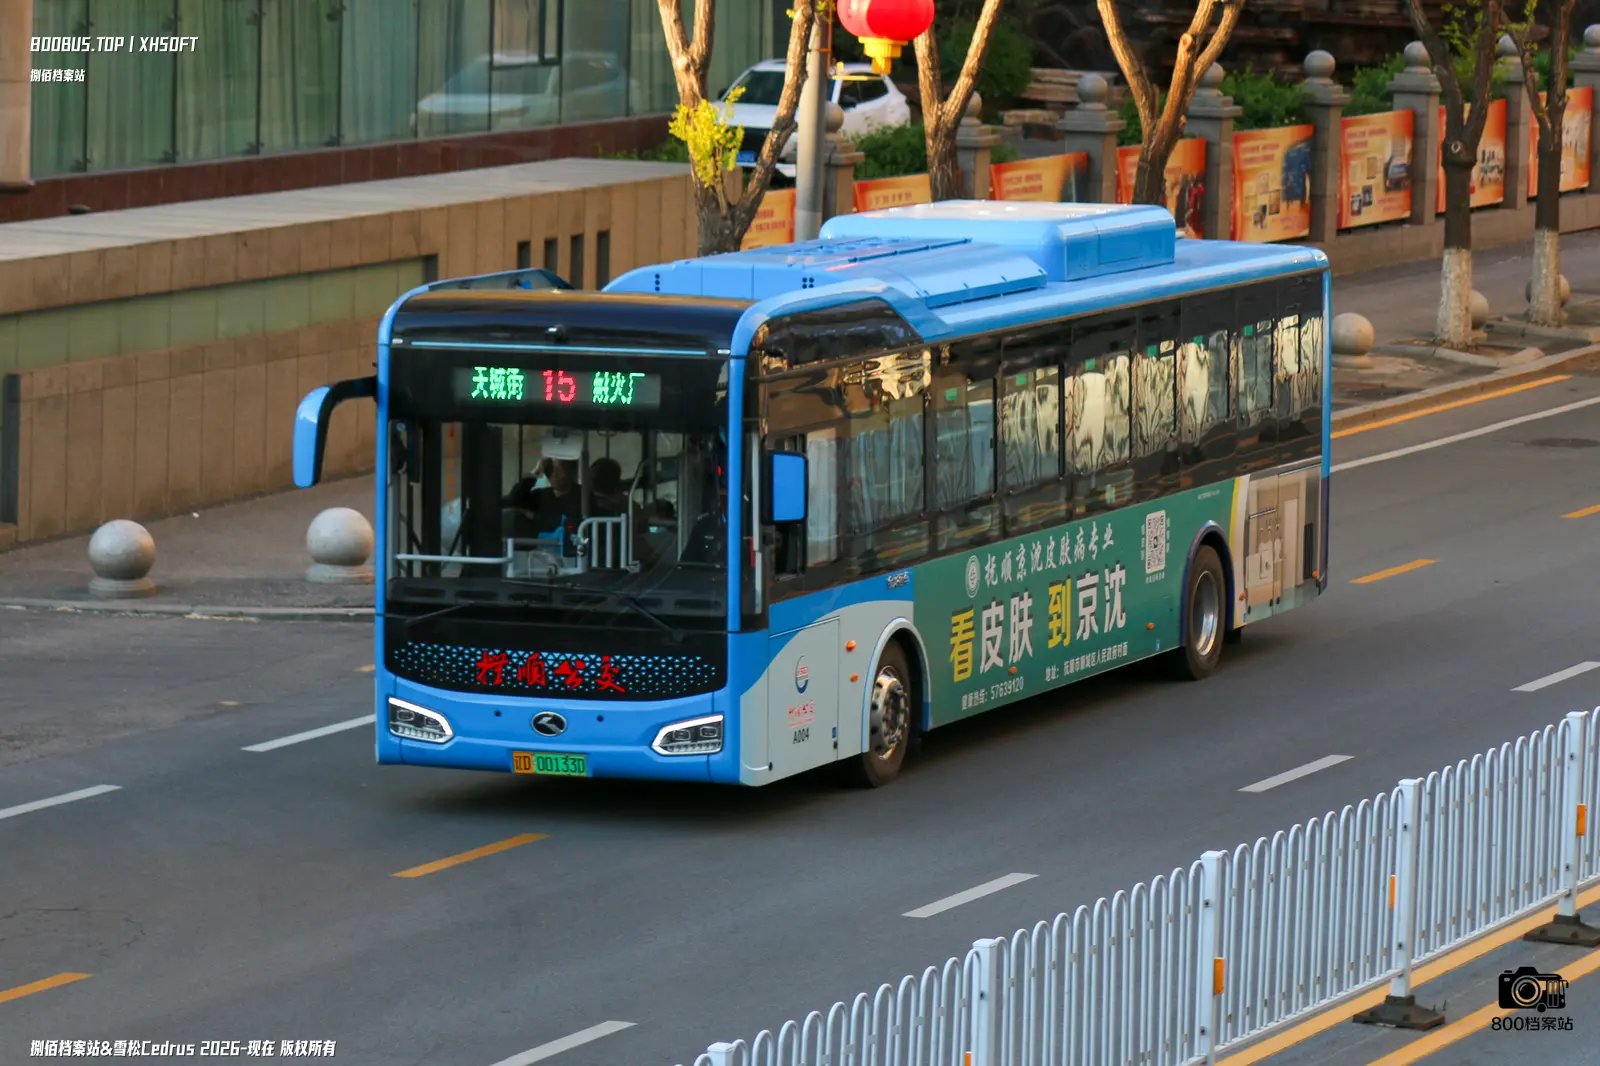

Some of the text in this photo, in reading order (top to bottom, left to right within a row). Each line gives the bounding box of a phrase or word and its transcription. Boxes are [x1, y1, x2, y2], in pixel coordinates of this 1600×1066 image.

[543, 370, 576, 402] 15
[984, 521, 1114, 588] 抚顺京沈皮肤病专业
[949, 590, 1033, 682] 看皮肤
[1048, 562, 1126, 649] 到京沈
[793, 727, 810, 744] A004
